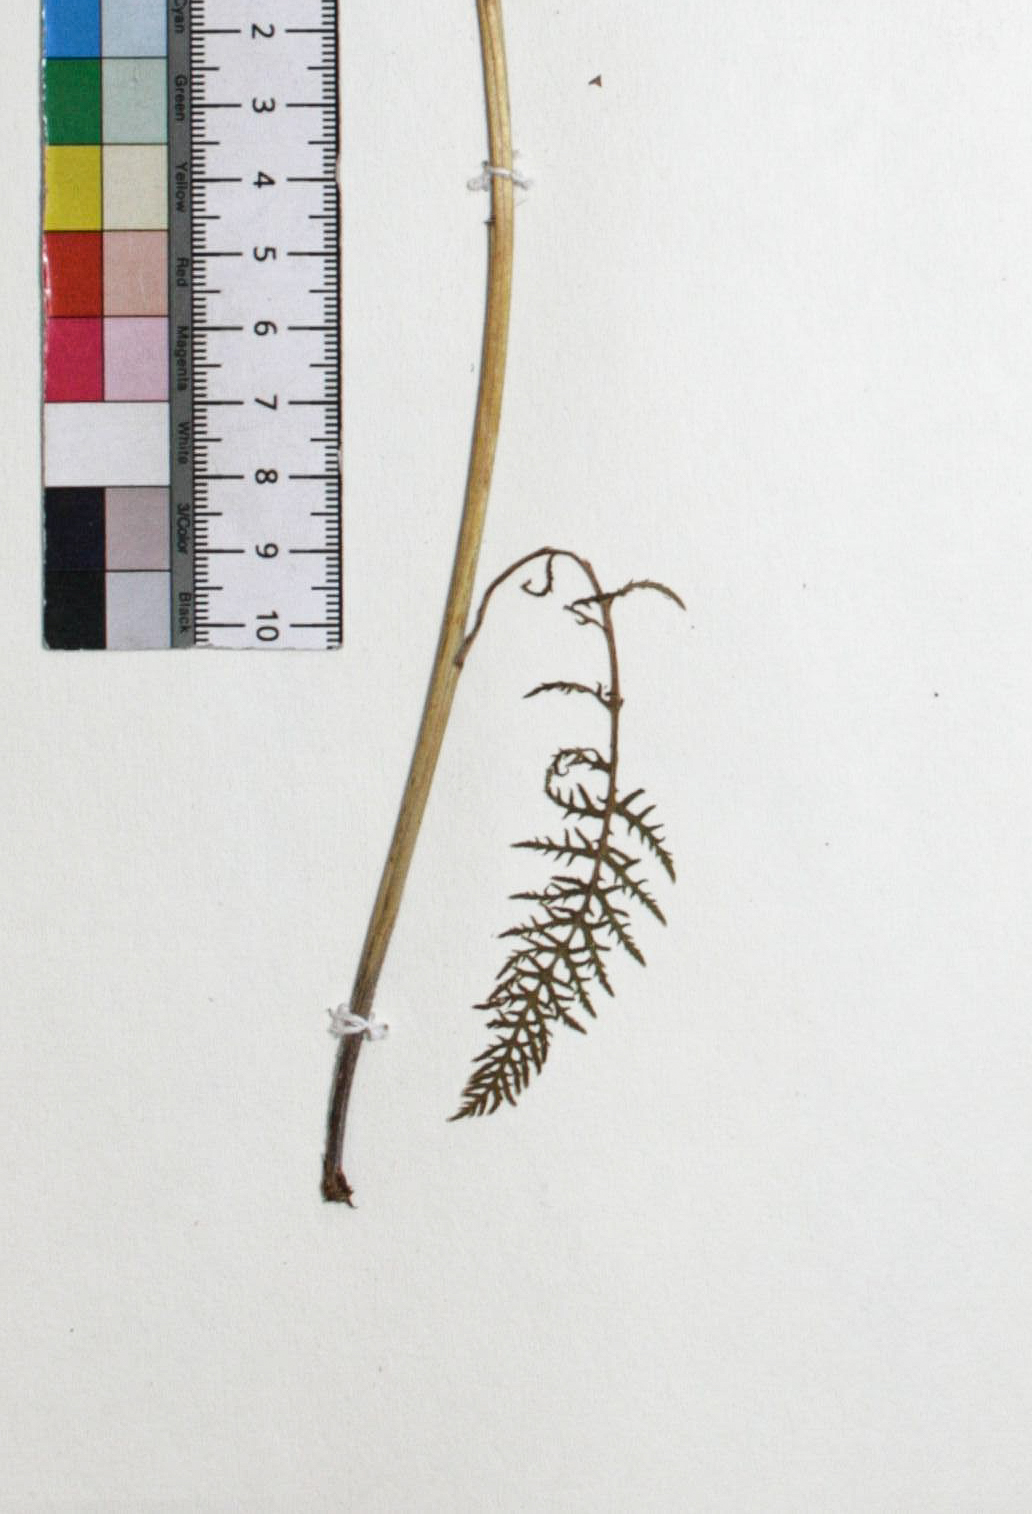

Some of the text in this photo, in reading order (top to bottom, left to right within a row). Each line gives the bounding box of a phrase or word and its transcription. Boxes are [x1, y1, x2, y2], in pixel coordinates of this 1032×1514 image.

[251, 23, 276, 39] 2
[174, 74, 188, 122] Green
[251, 97, 276, 114] 3
[175, 160, 188, 213] Yellow
[252, 170, 276, 189] 4
[252, 246, 277, 263] 5
[176, 255, 190, 288] Red
[253, 320, 278, 337] 6
[175, 325, 188, 391] Magenta
[254, 394, 278, 411] 7
[178, 421, 190, 465] White
[254, 468, 279, 485] 8
[255, 542, 280, 559] 9
[178, 591, 192, 634] Black
[255, 610, 280, 642] 10
